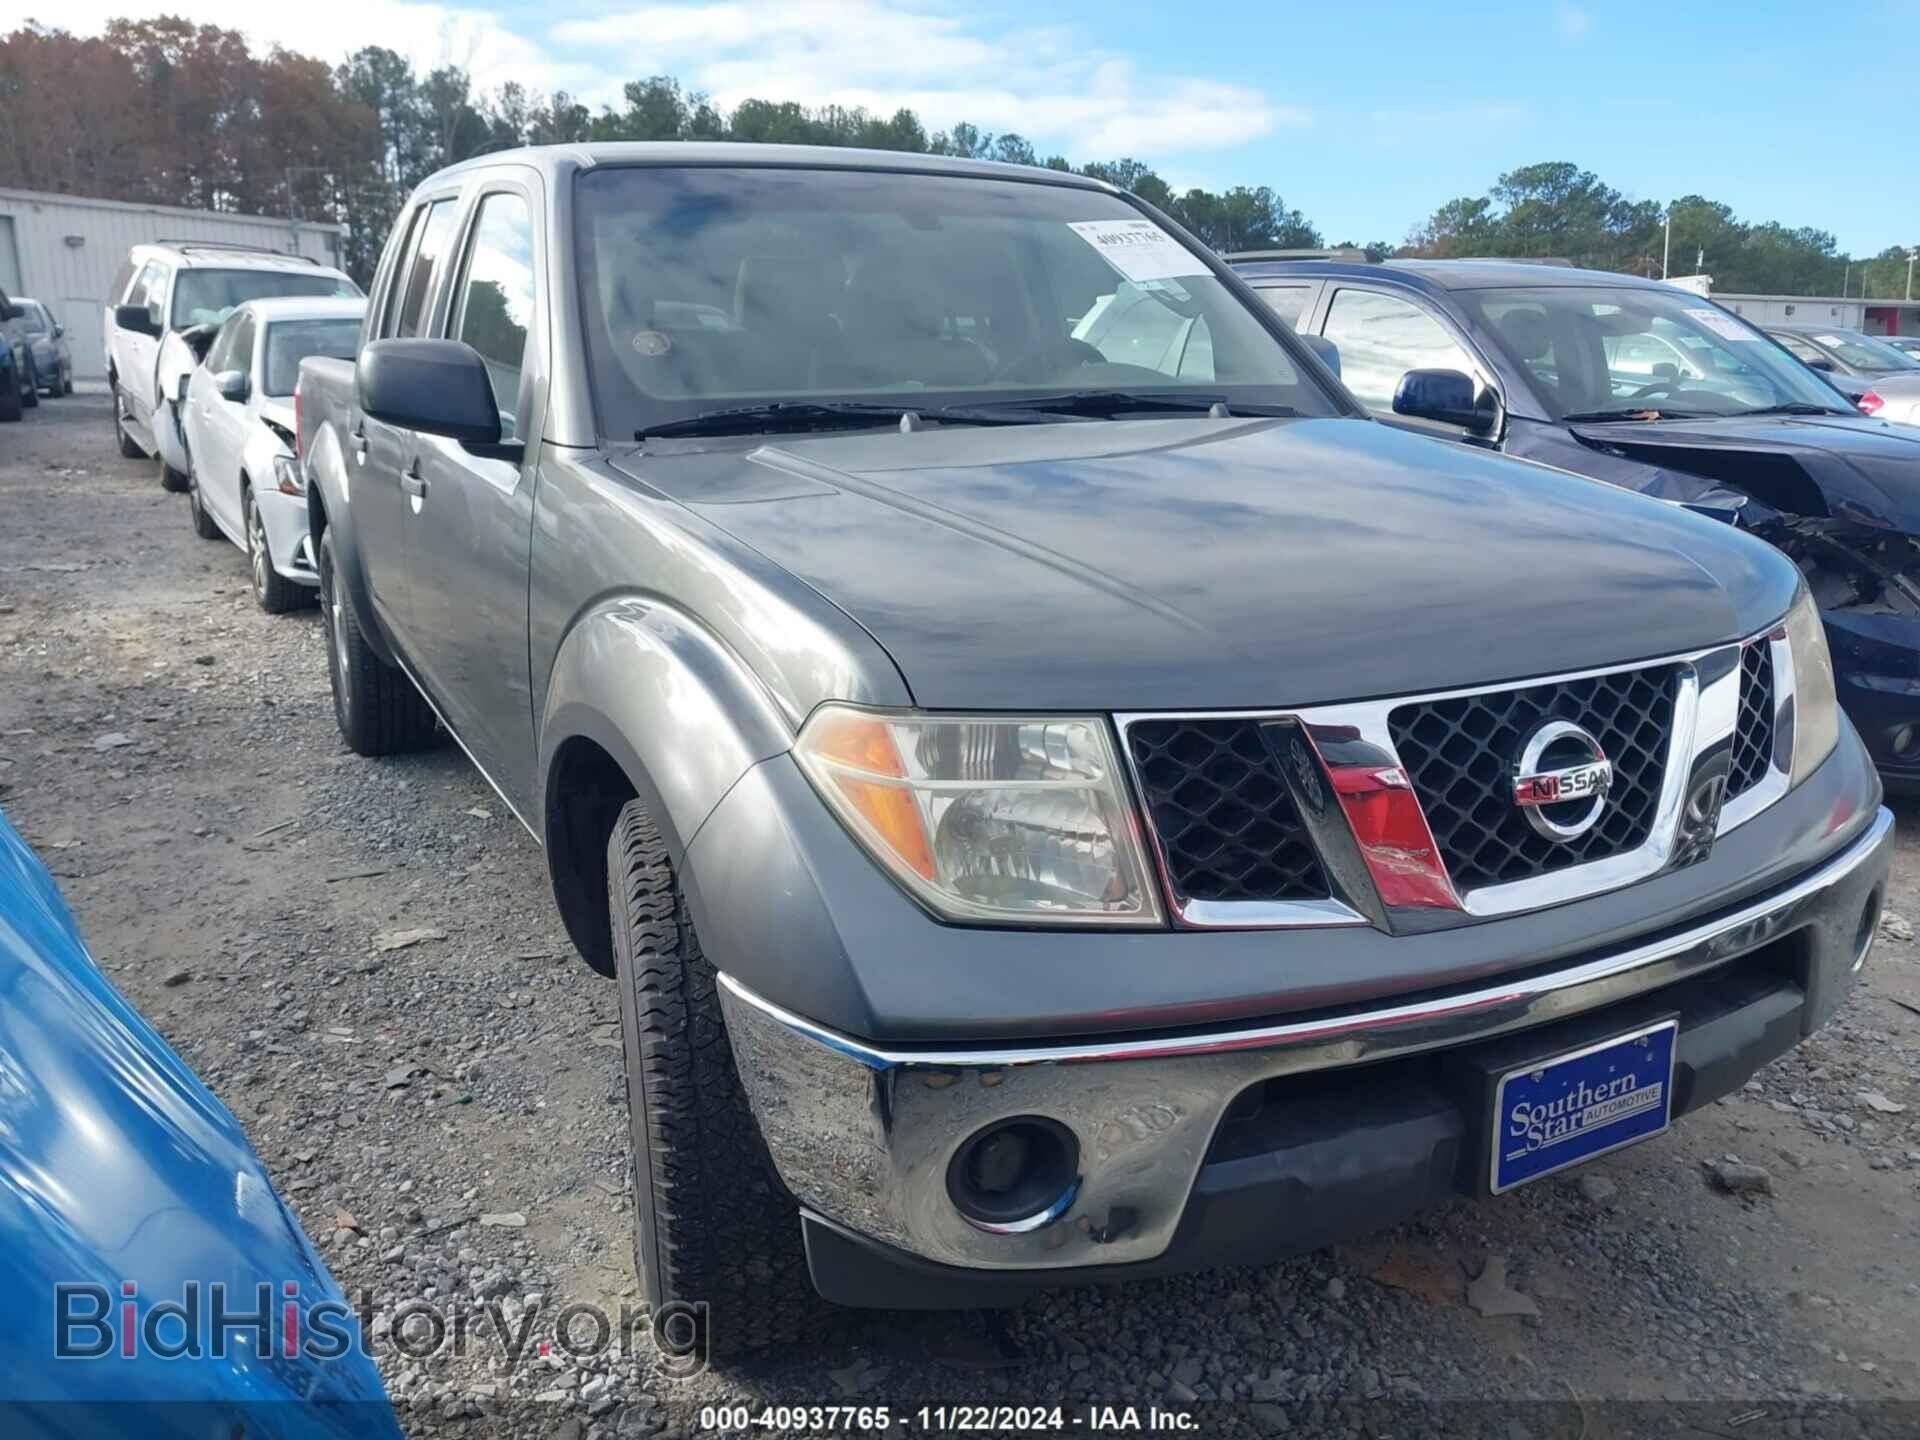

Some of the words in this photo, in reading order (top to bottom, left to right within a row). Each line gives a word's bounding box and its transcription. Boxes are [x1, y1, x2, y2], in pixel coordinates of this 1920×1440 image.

[1532, 766, 1611, 797] NISSAN
[1510, 1073, 1637, 1137] Southern
[1526, 1109, 1584, 1152] Star
[1584, 1087, 1659, 1122] AUTOMOTIVE
